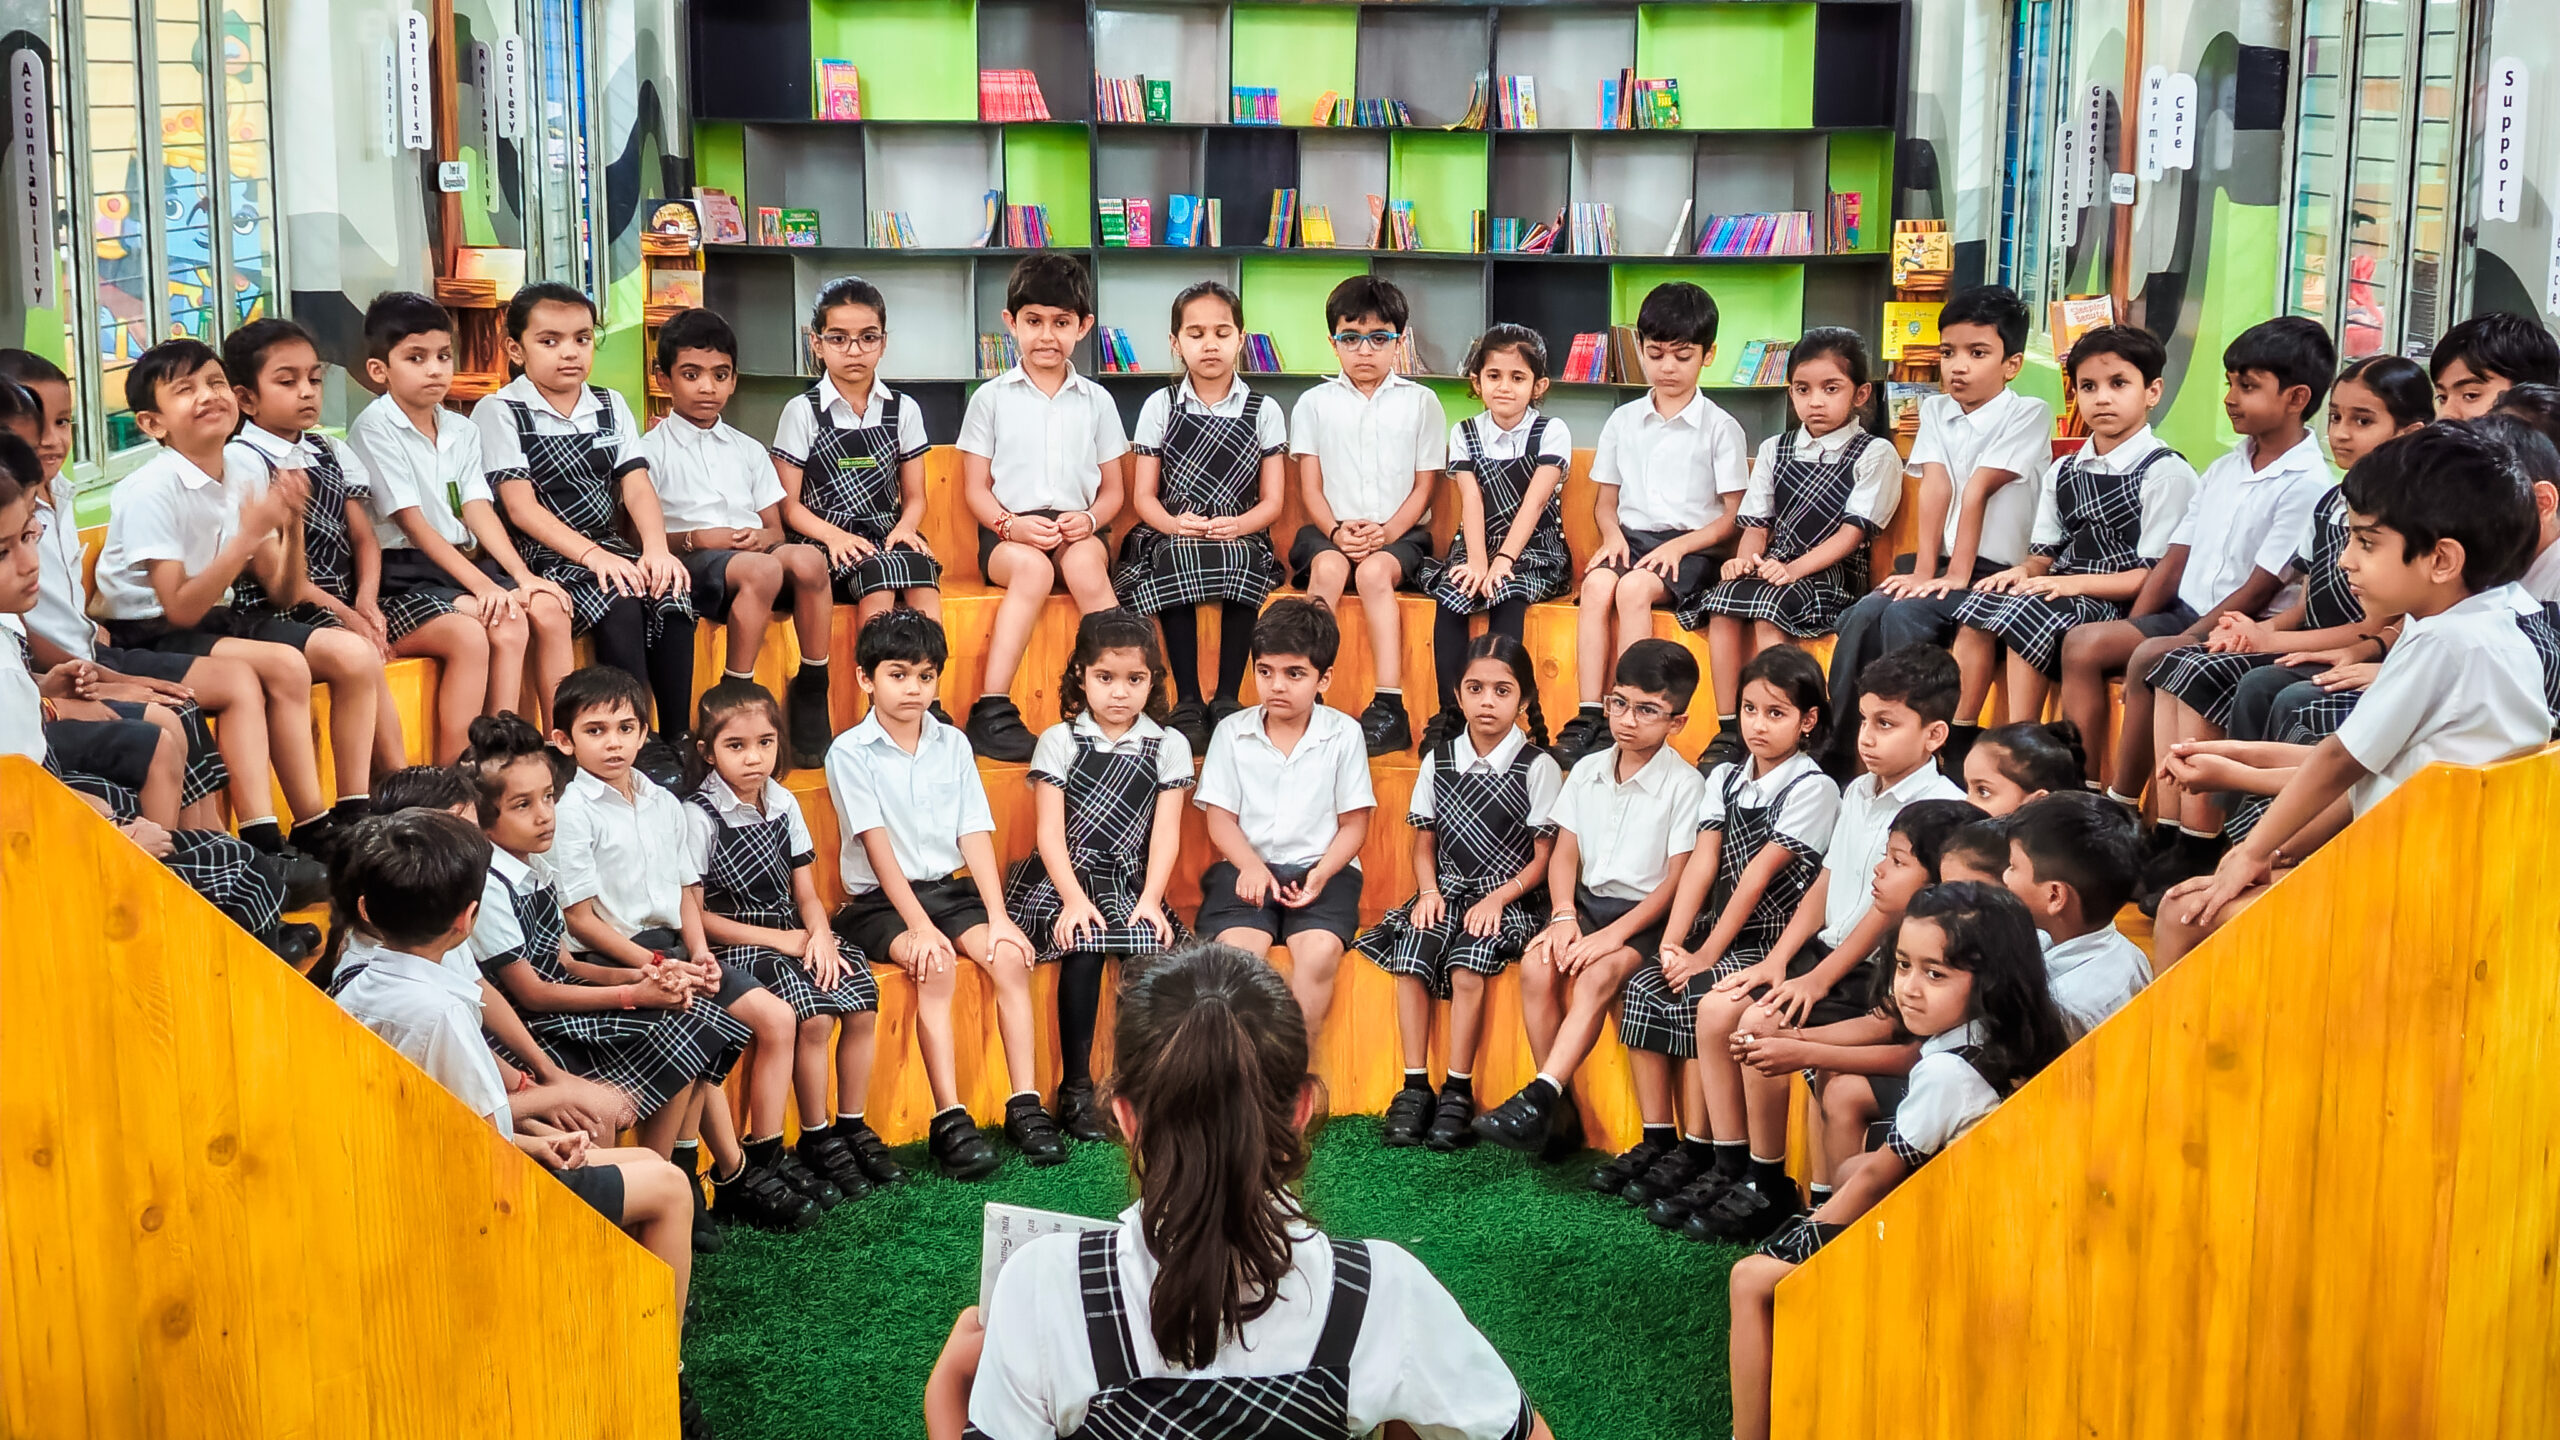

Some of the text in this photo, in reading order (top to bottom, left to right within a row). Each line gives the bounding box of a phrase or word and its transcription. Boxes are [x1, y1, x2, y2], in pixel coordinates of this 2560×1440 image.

[408, 18, 423, 144] Patriotism
[478, 48, 490, 206] Reliability
[505, 39, 516, 134] Courtesy
[2148, 78, 2162, 170] Warmth
[2174, 95, 2185, 149] Care
[21, 61, 43, 304] Accountability
[2060, 130, 2073, 242] Politeness
[2087, 85, 2100, 203] Generosity
[2499, 70, 2514, 213] Support
